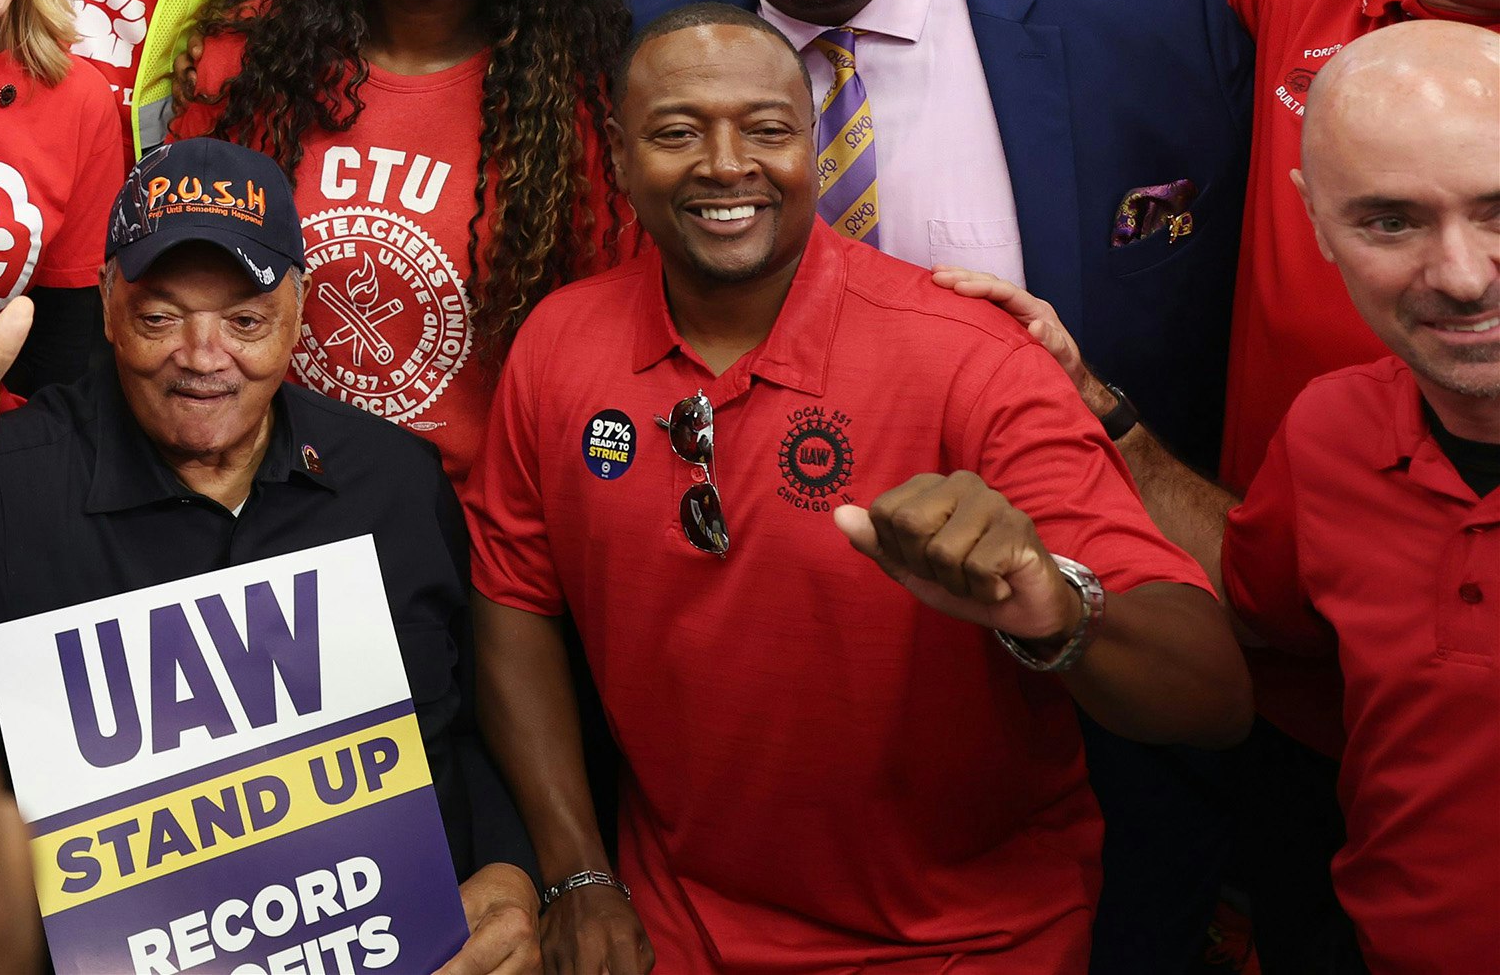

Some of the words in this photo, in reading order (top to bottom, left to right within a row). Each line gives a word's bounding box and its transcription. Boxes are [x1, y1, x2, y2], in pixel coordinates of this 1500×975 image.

[1275, 85, 1299, 112] BUILT
[320, 145, 452, 215] CTU
[818, 157, 838, 181] ΨΦ
[148, 210, 164, 219] Pray
[166, 206, 183, 214] Until
[186, 205, 229, 216] Something
[378, 248, 432, 304] UNITE
[313, 217, 449, 287] TEACHERS
[432, 294, 464, 371] UNION
[301, 324, 329, 368] EST.
[335, 365, 379, 391] 1937
[389, 312, 438, 385] DEFEND
[295, 352, 335, 394] AFT
[414, 379, 431, 395] 1
[592, 419, 631, 441] 97%
[787, 406, 825, 424] LOCAL
[831, 410, 852, 427] 551
[589, 446, 628, 463] STRIKE
[590, 437, 617, 449] READY
[618, 442, 629, 451] TO
[800, 447, 831, 466] UAW
[777, 486, 830, 512] CHICAGO
[55, 569, 322, 769] UAW
[55, 775, 291, 893] STAND
[309, 737, 400, 805] UP
[127, 856, 382, 975] RECORD
